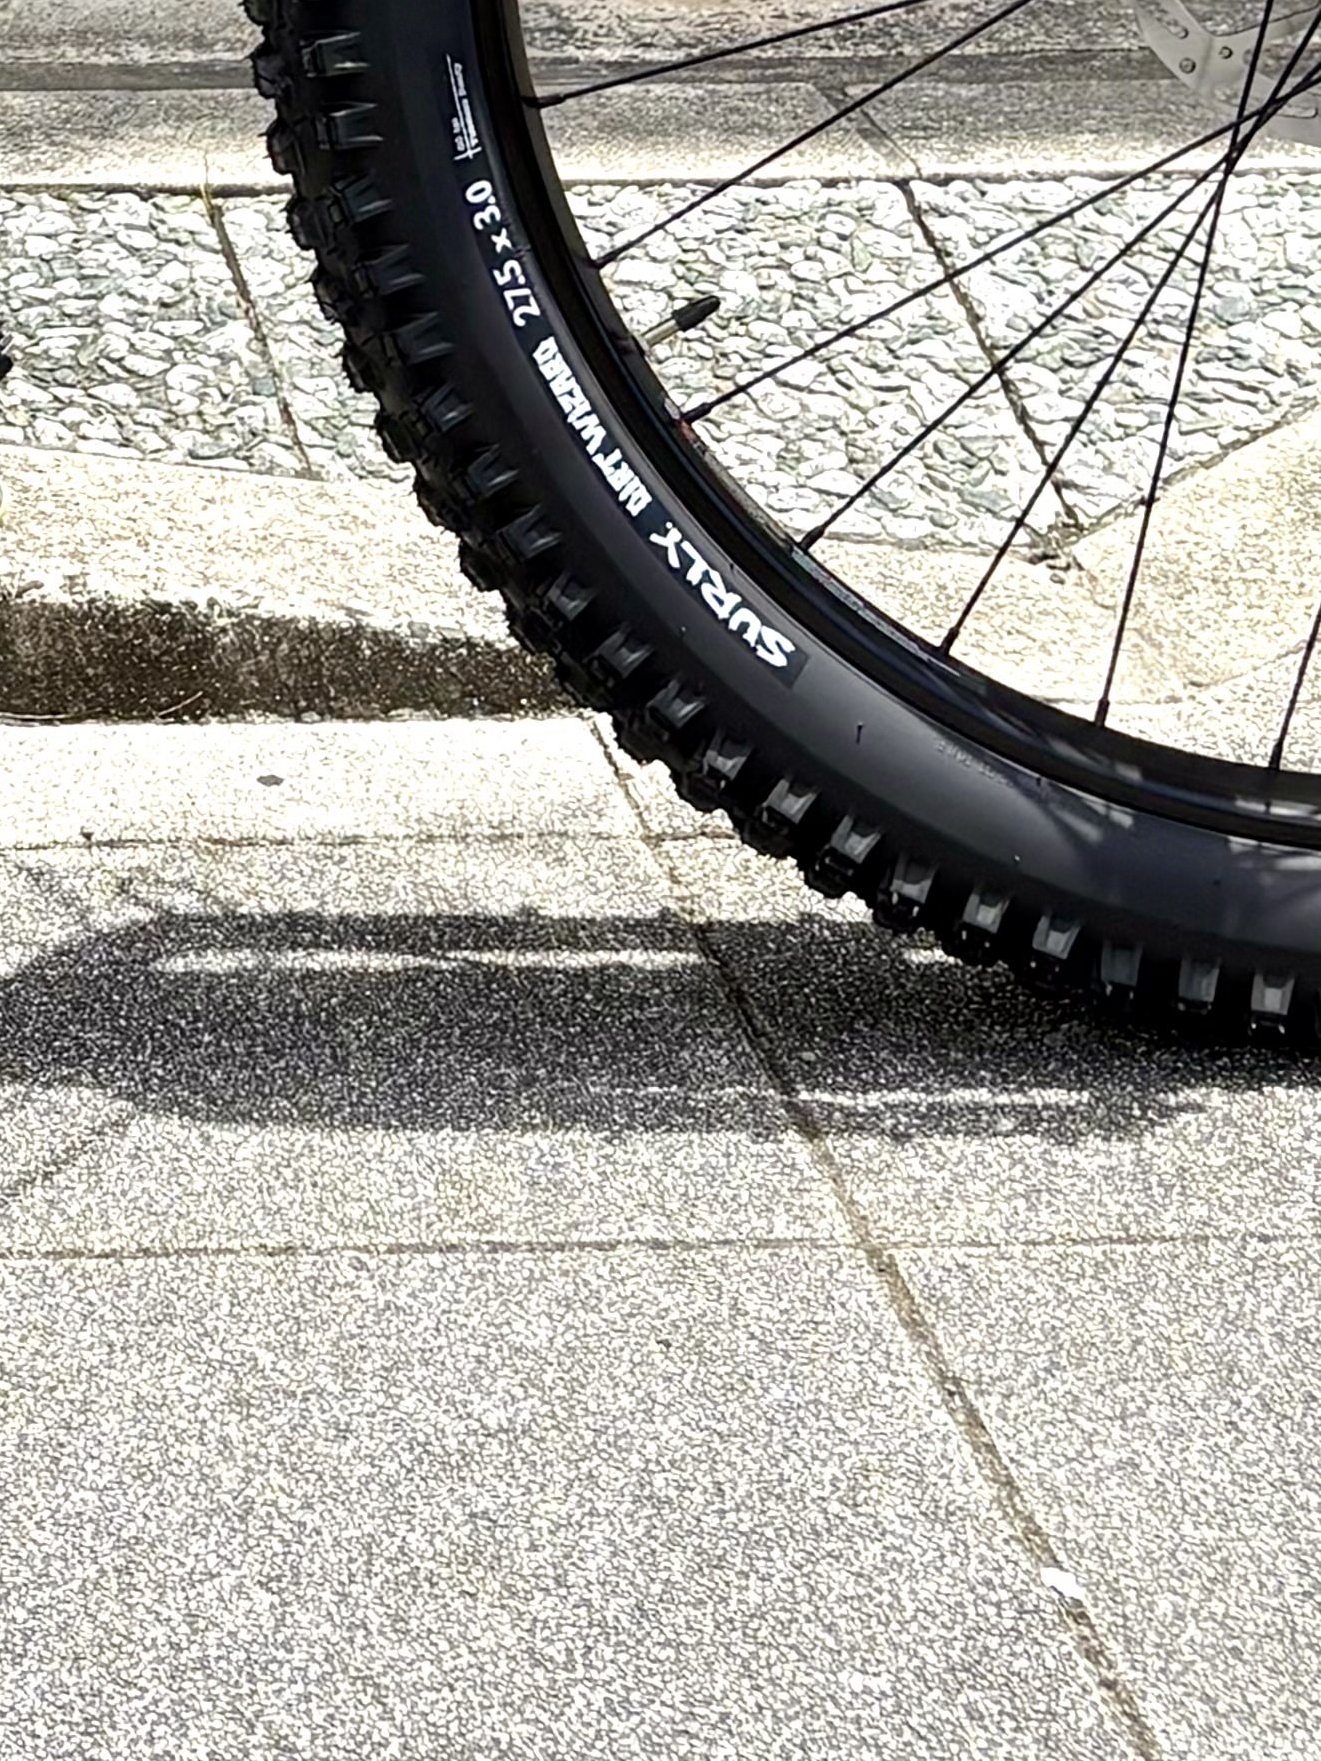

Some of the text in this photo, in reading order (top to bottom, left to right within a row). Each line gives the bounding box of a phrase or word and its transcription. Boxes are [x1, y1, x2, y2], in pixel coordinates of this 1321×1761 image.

[465, 180, 503, 232] 3.0
[494, 232, 513, 255] x
[493, 258, 542, 327] 27.5
[532, 336, 605, 461] WIZARD
[593, 448, 654, 517] DIRT
[650, 520, 796, 669] SURLY
